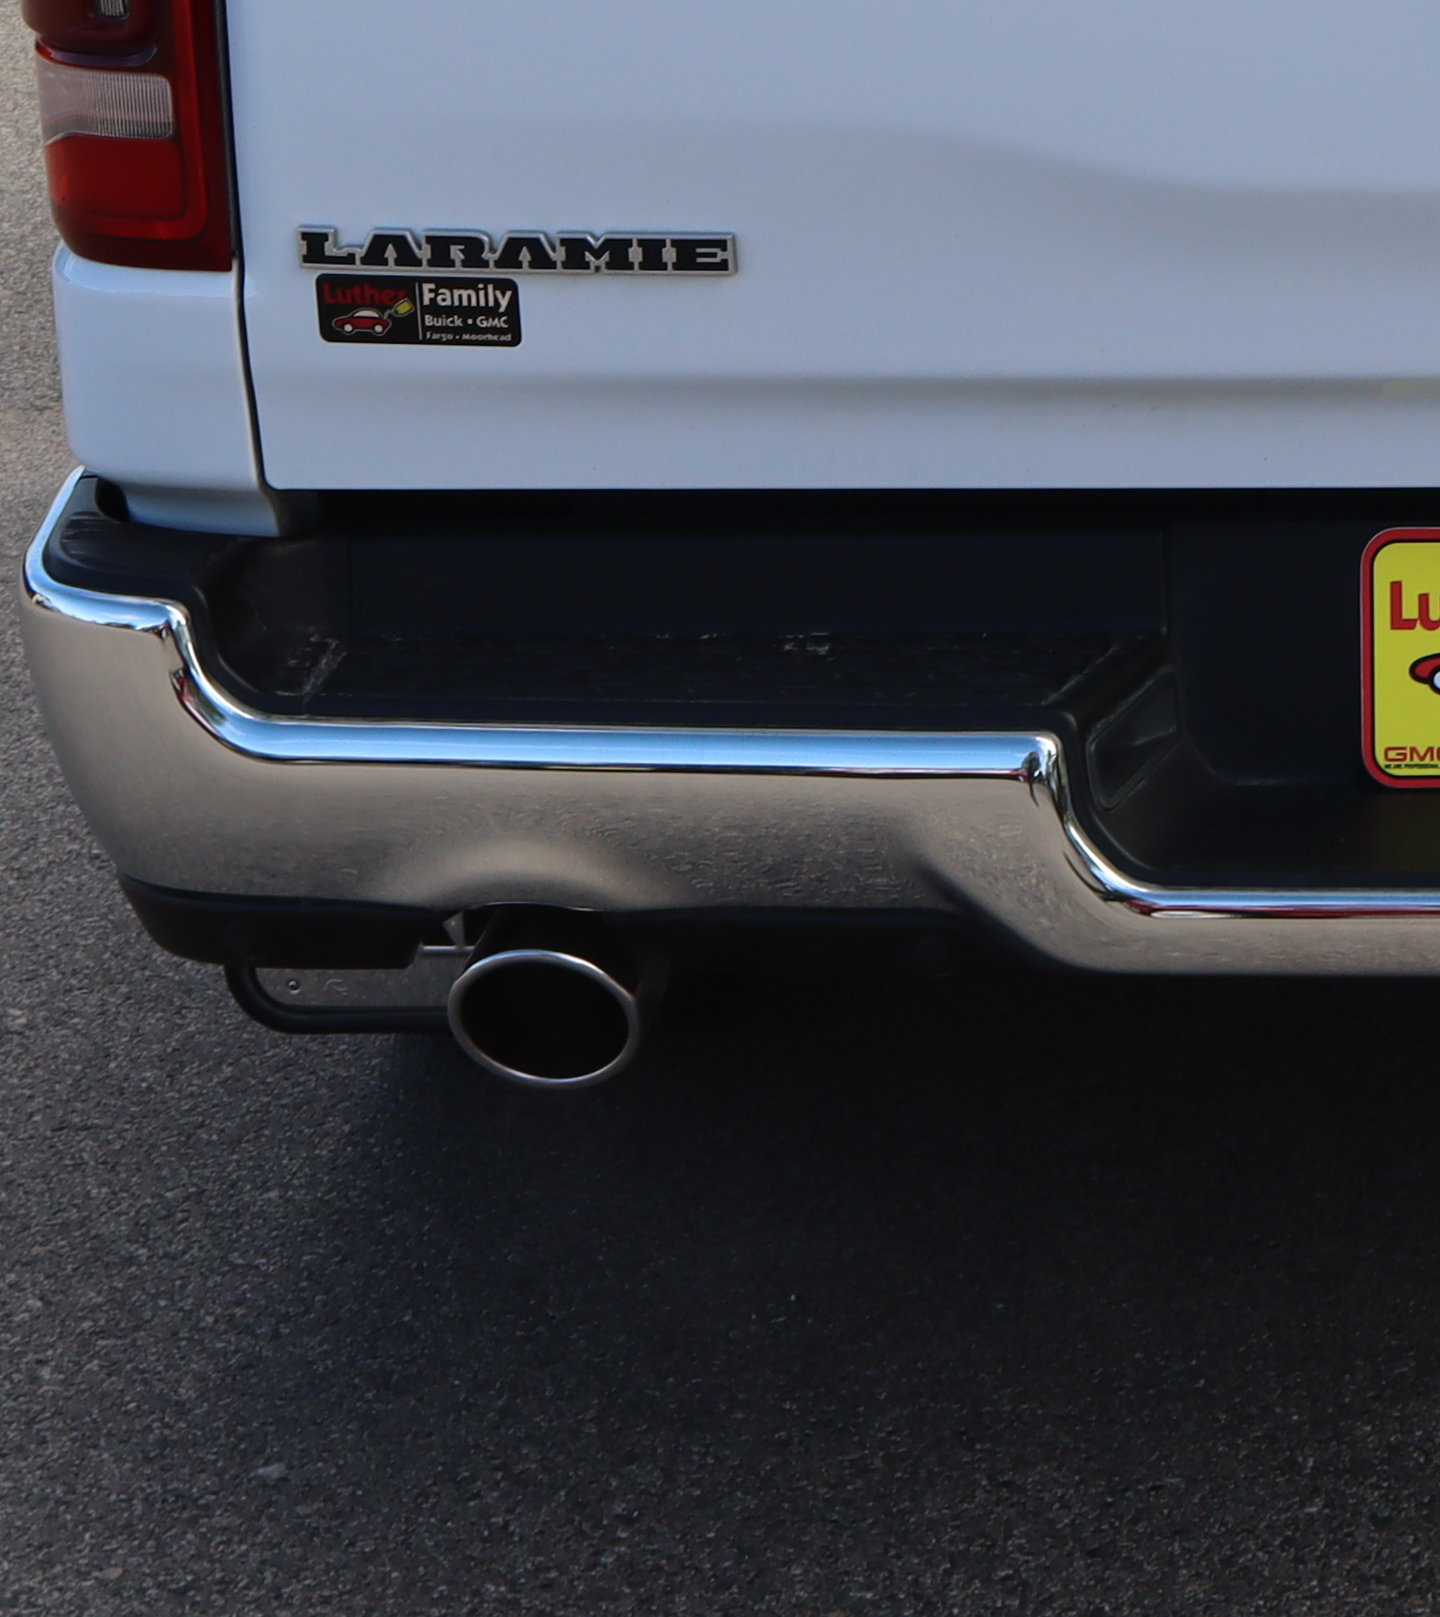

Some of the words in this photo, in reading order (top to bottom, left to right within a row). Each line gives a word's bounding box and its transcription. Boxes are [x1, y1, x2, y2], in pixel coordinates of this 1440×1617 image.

[297, 225, 738, 276] LARAMIE
[323, 282, 411, 306] Luther
[422, 283, 513, 313] Family
[424, 314, 464, 328] Buick
[476, 316, 510, 329] GMC
[426, 331, 454, 342] Fargo
[462, 332, 513, 342] Moorhead
